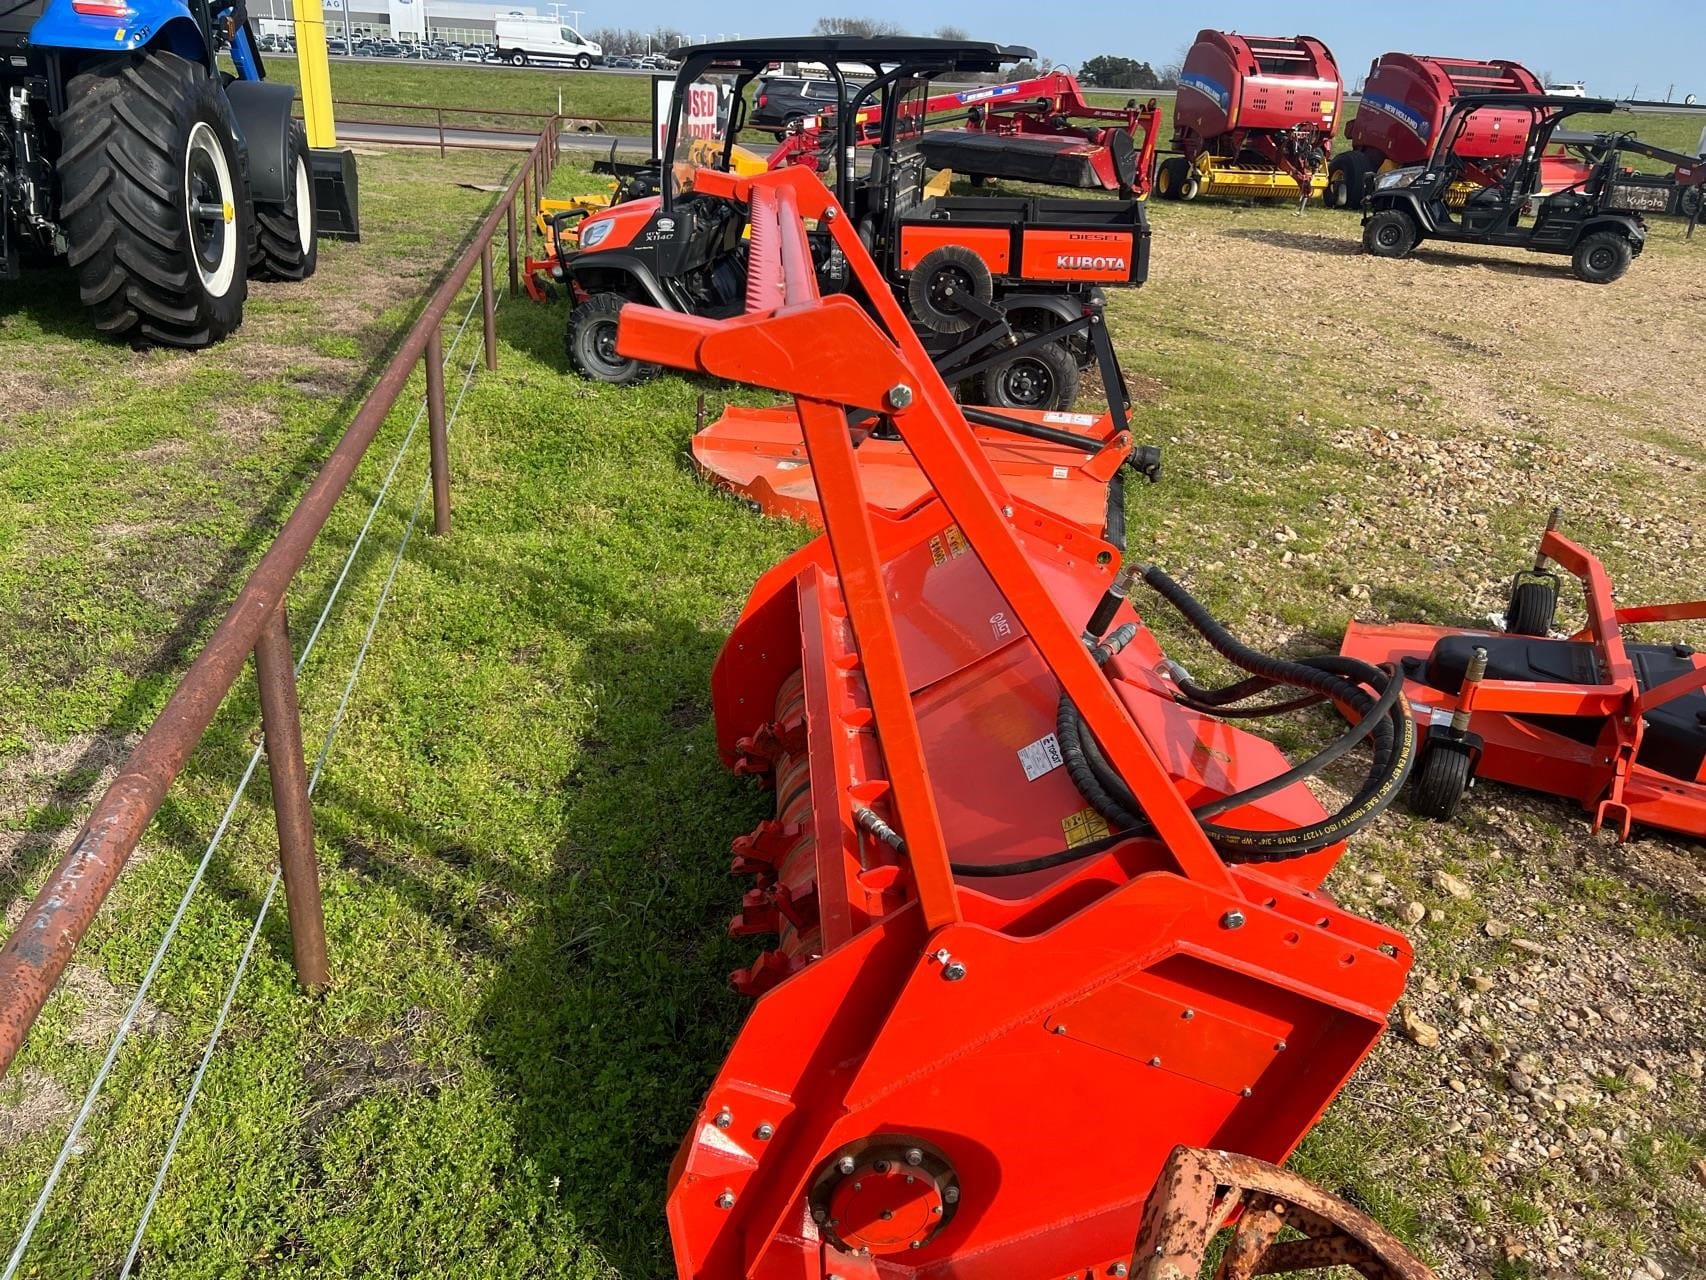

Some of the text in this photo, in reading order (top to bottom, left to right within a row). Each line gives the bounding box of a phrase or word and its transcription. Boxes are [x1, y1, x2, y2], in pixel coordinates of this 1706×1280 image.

[1395, 107, 1418, 130] HOLLAND
[1626, 195, 1664, 207] Kubota
[1057, 255, 1126, 271] KUBOTA
[1404, 720, 1413, 748] EXCEEDS
[1401, 747, 1411, 759] DIN
[1397, 758, 1407, 769] EN
[1380, 782, 1393, 796] 2SC
[1363, 796, 1379, 811] SAE
[1341, 808, 1366, 826] 100R16
[1303, 829, 1324, 840] 11237
[1324, 824, 1338, 834] ISO
[1277, 836, 1297, 845] DN19
